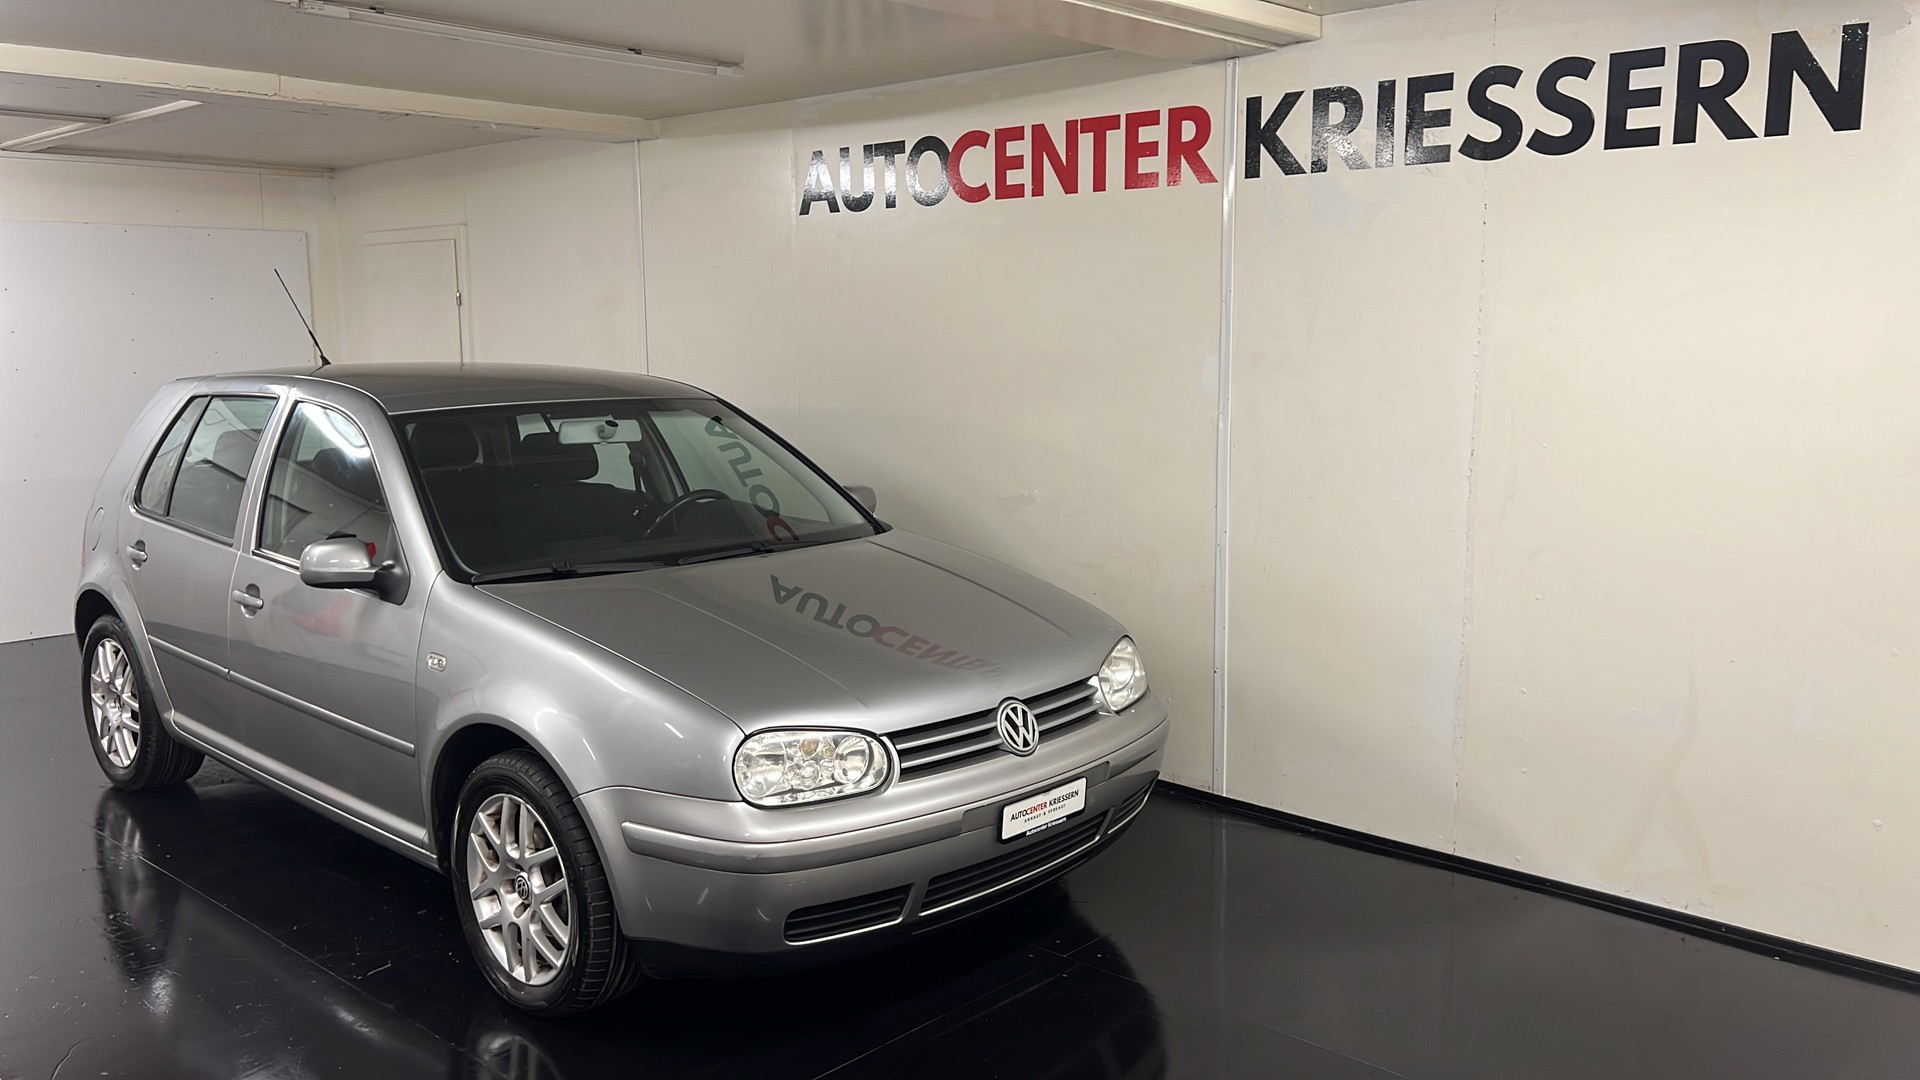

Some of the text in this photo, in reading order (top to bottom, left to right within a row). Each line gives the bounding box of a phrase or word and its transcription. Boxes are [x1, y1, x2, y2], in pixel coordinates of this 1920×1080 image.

[799, 22, 1870, 215] AUTOCENTER KRIESSERN
[1010, 789, 1079, 821] AUTOCENTER KRIESSERN
[1026, 824, 1048, 836] Autocenter
